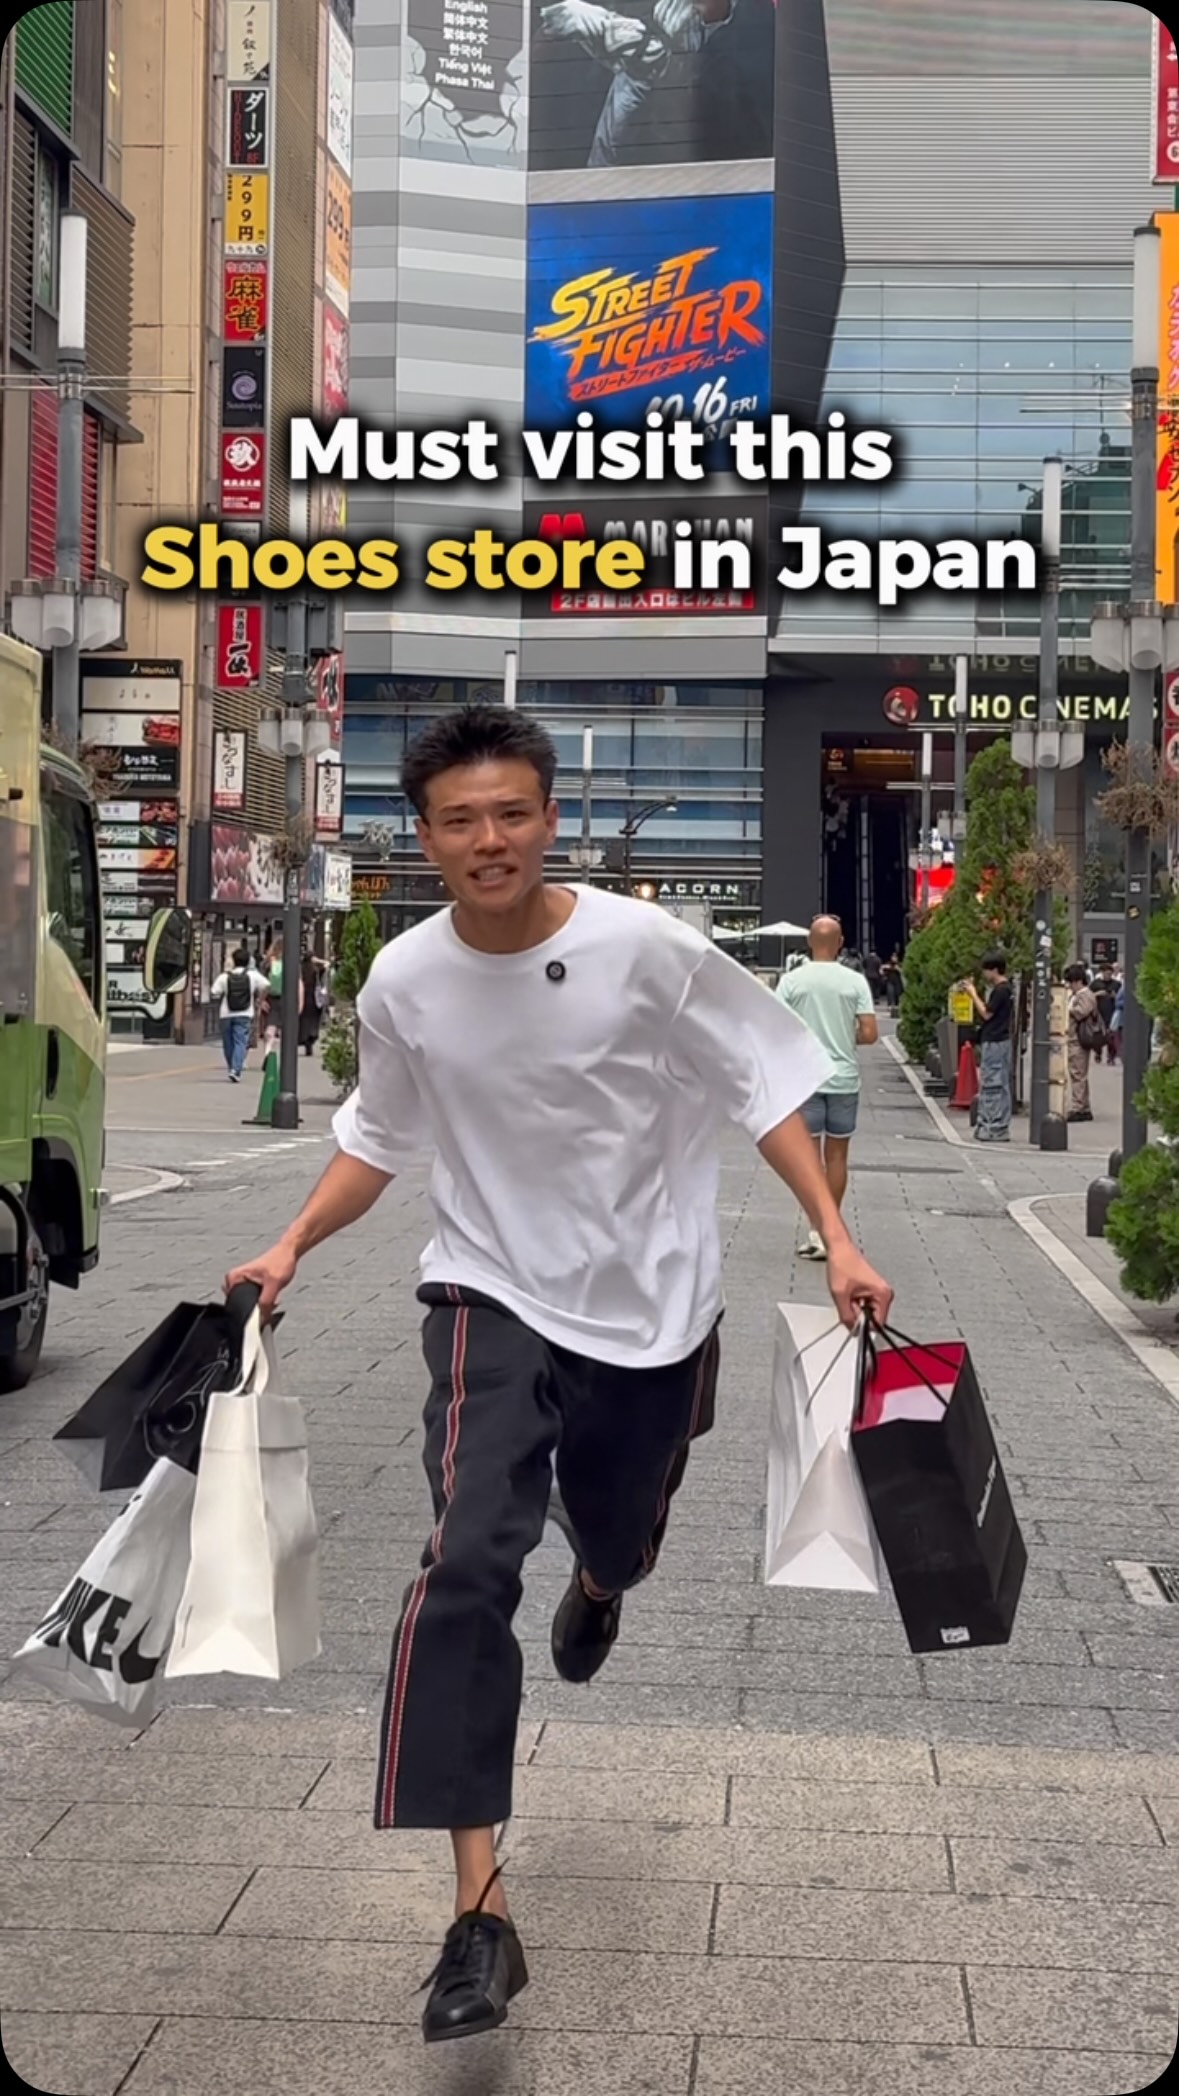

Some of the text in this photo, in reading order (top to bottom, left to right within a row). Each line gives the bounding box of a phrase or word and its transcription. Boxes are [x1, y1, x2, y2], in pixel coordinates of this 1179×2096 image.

[444, 0, 488, 13] English
[449, 43, 482, 59] 한국어
[435, 72, 495, 90] Phasa Thai
[244, 92, 264, 150] ダーツ
[238, 174, 253, 241] 299円
[227, 276, 262, 330] 麻雀
[527, 247, 719, 343] STREET
[552, 279, 766, 381] FIGHTER
[729, 395, 757, 416] FRI
[1020, 695, 1158, 720] CNEMA
[659, 883, 738, 895] ACORN
